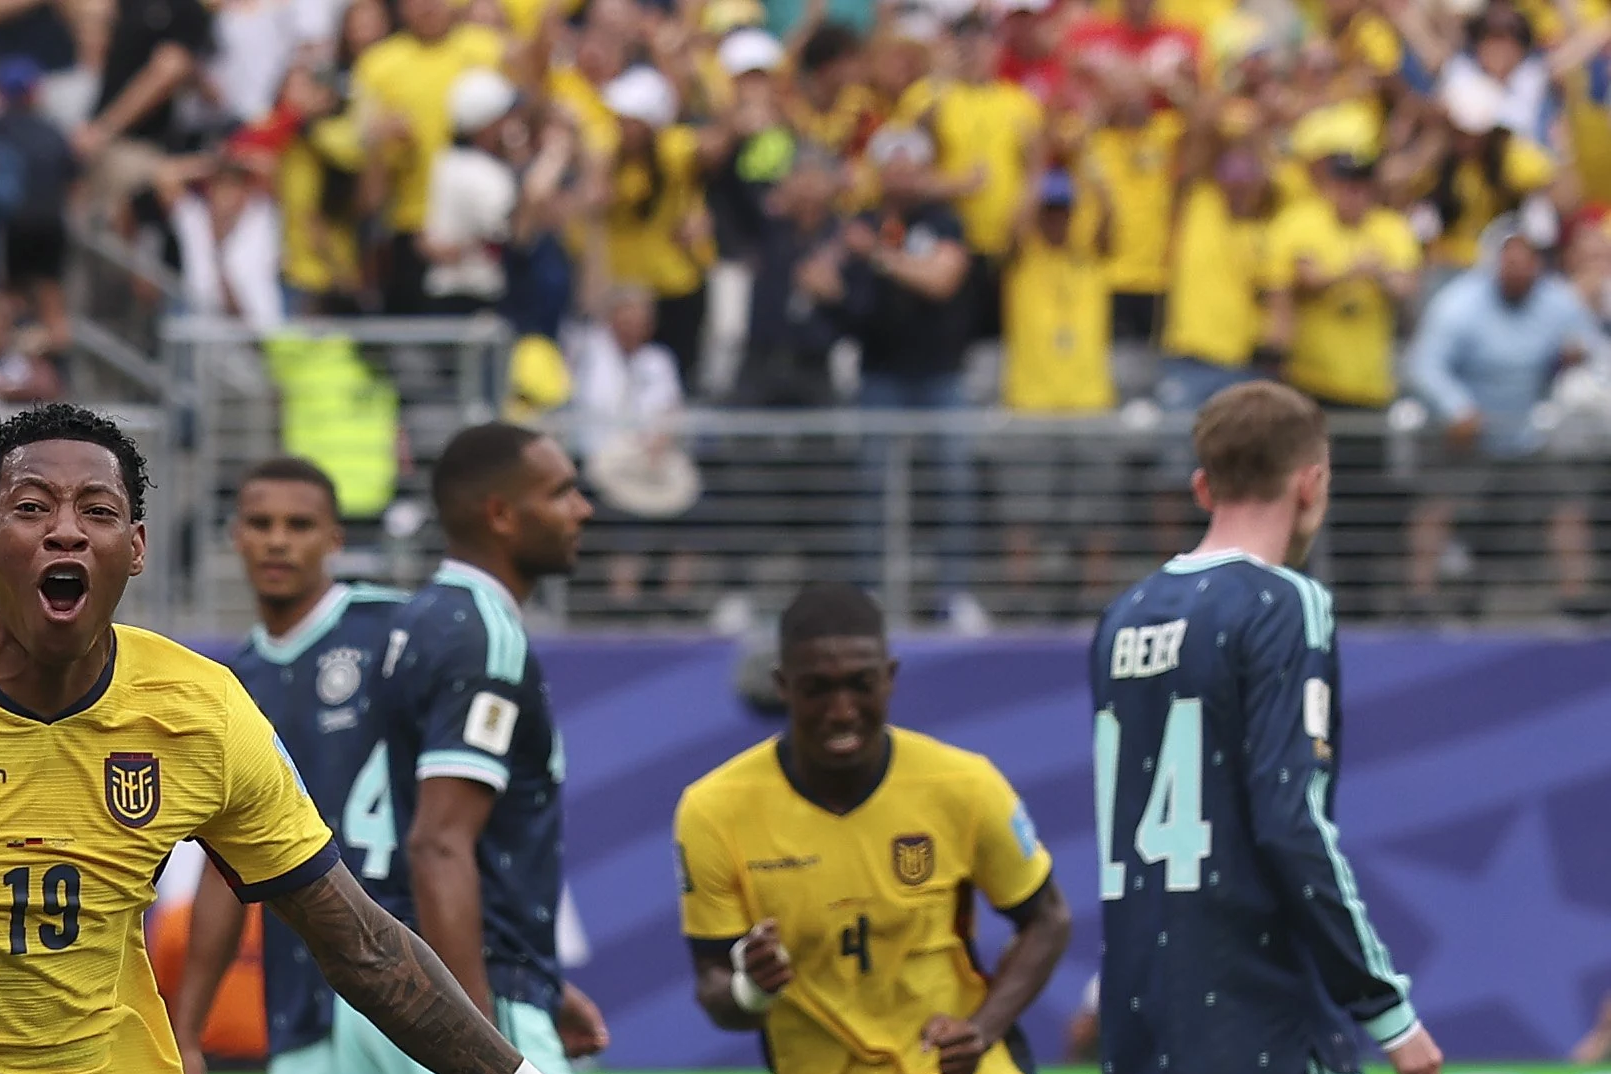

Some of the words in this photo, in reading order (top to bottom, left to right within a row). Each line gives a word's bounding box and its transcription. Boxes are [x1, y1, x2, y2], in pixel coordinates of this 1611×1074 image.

[341, 739, 397, 880] 4
[1094, 697, 1212, 901] 14
[3, 863, 81, 955] 19
[840, 913, 871, 974] 4
